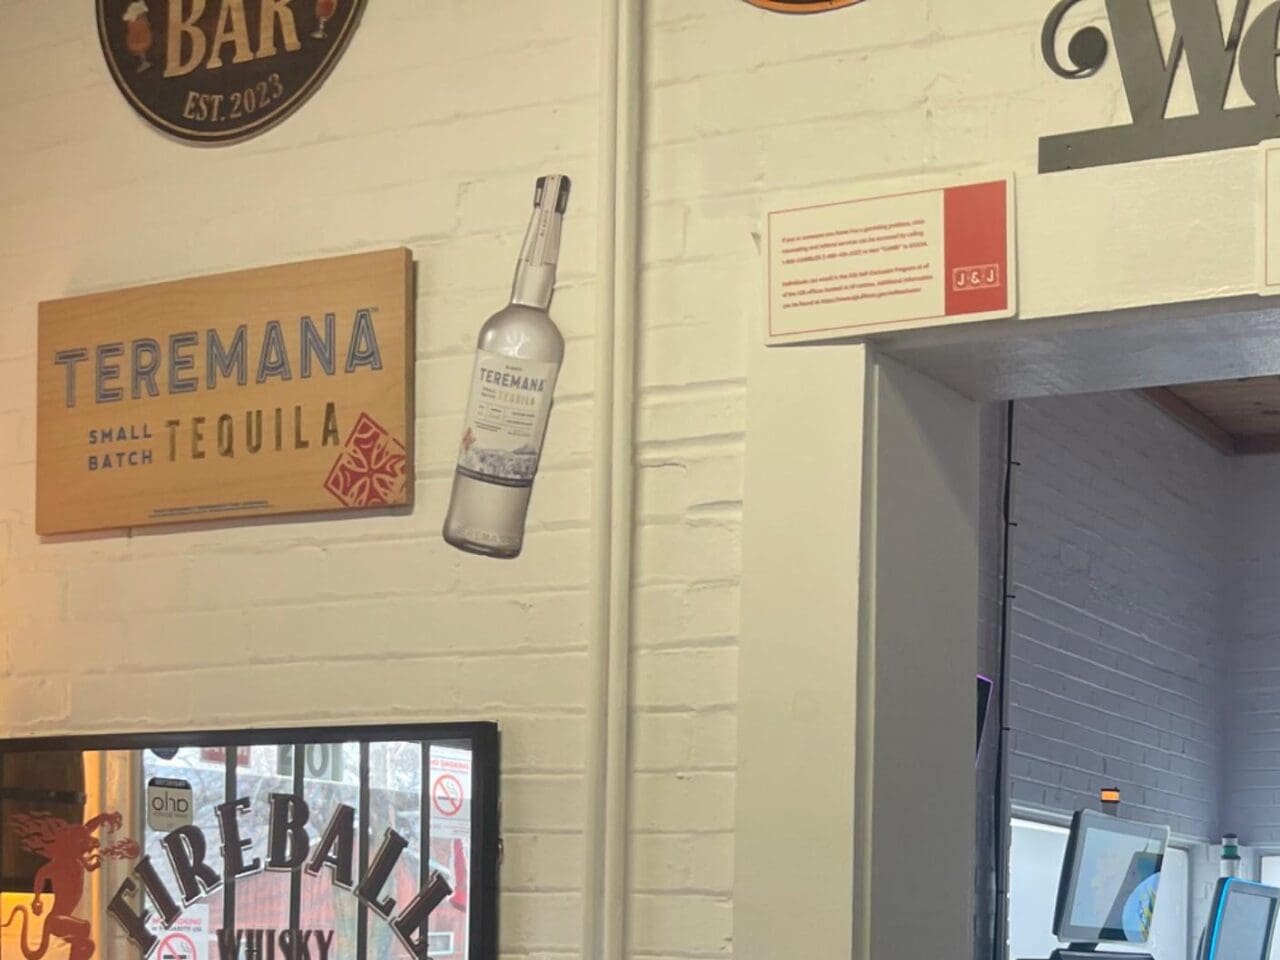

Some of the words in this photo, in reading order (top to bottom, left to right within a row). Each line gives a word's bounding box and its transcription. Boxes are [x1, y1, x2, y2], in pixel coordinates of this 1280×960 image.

[182, 90, 227, 122] EST.
[230, 72, 284, 119] 2023
[54, 308, 383, 408] TEREMANA
[480, 367, 544, 393] TEREMANA
[88, 423, 152, 445] SMALL
[165, 401, 340, 462] TEQUILA
[88, 449, 152, 471] BATCH
